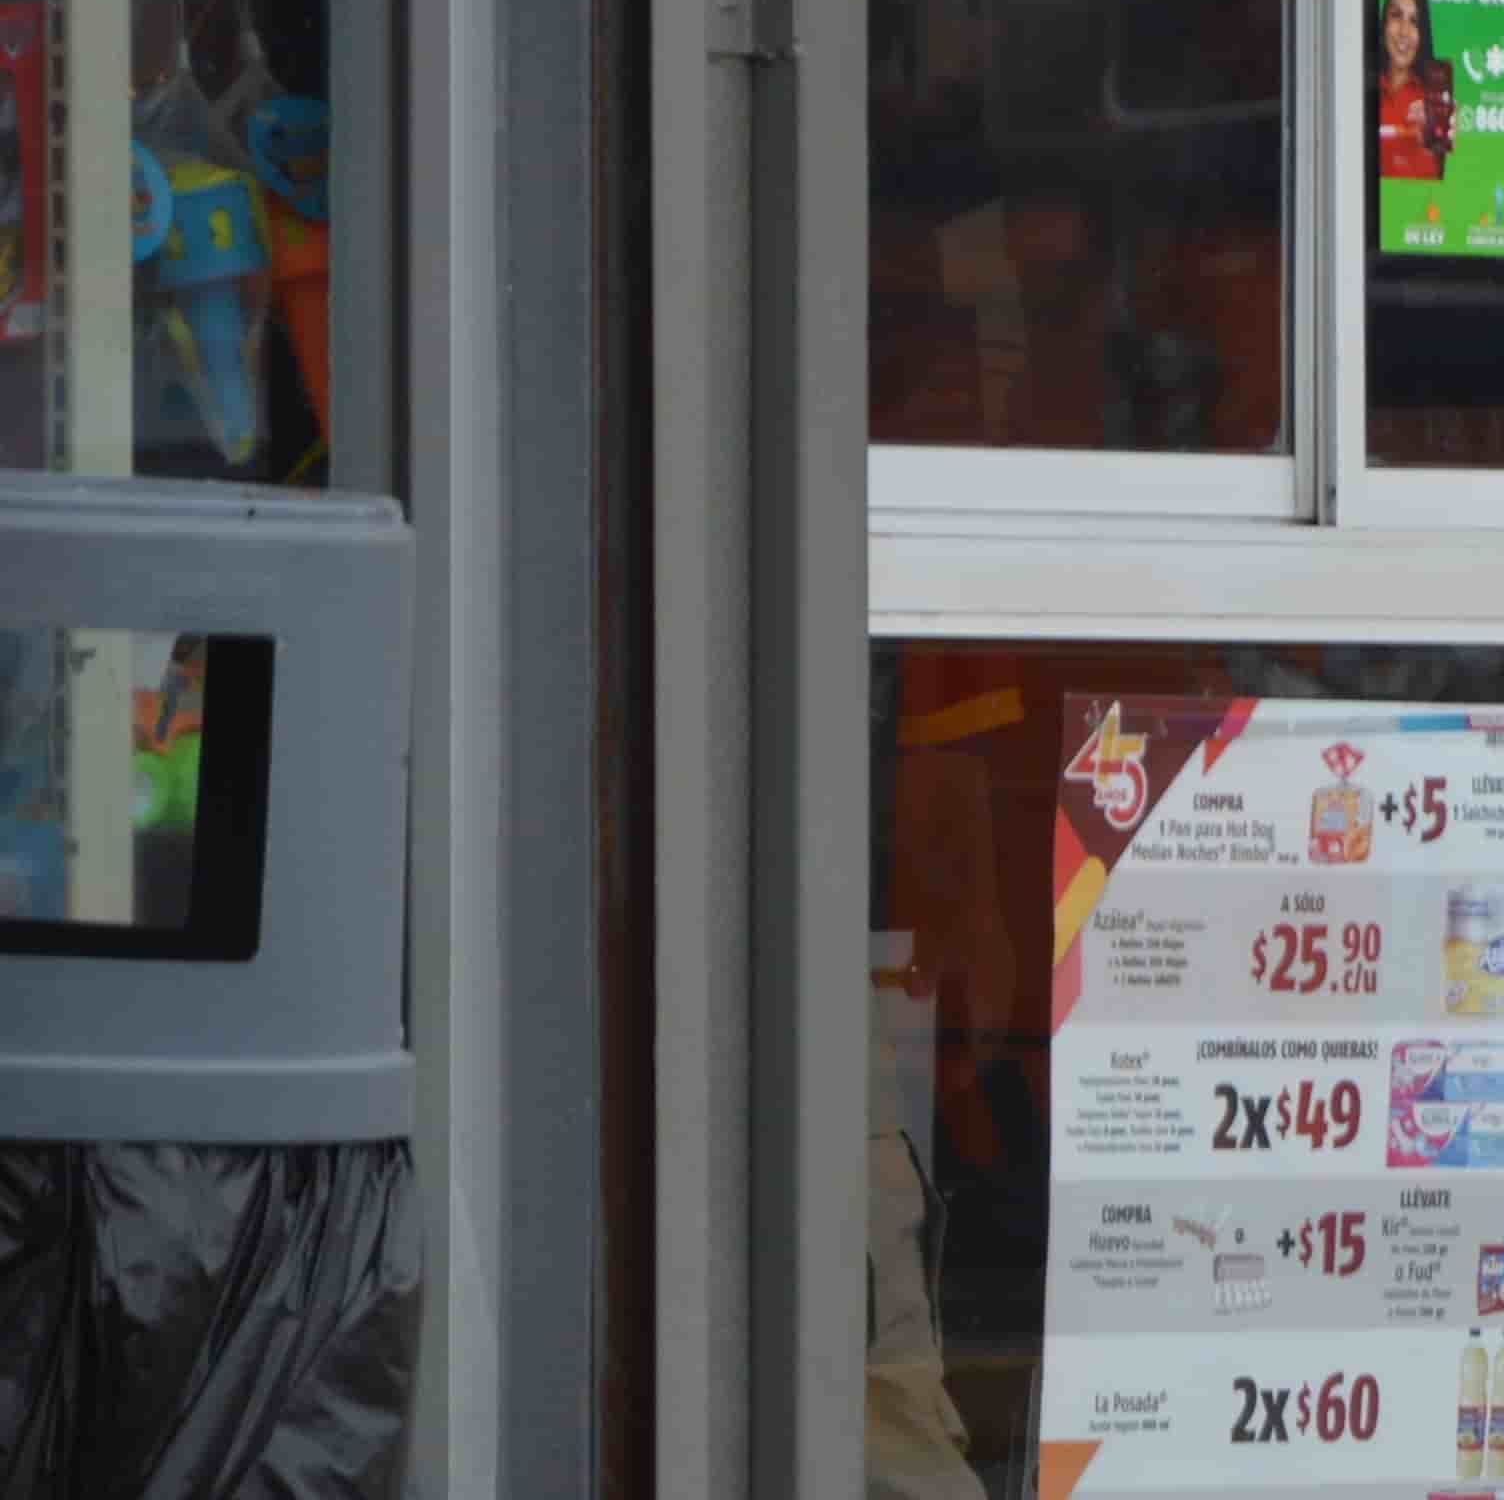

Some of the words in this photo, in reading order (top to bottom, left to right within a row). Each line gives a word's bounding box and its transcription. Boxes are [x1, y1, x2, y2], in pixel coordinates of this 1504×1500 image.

[1192, 793, 1244, 813] COMPRA
[1281, 1040, 1317, 1060] COMO
[1321, 1040, 1379, 1063] QUIERAS!
[1400, 1186, 1451, 1210] LLÉVATE
[1101, 1203, 1153, 1225] COMPRA
[1094, 1391, 1109, 1414] La
